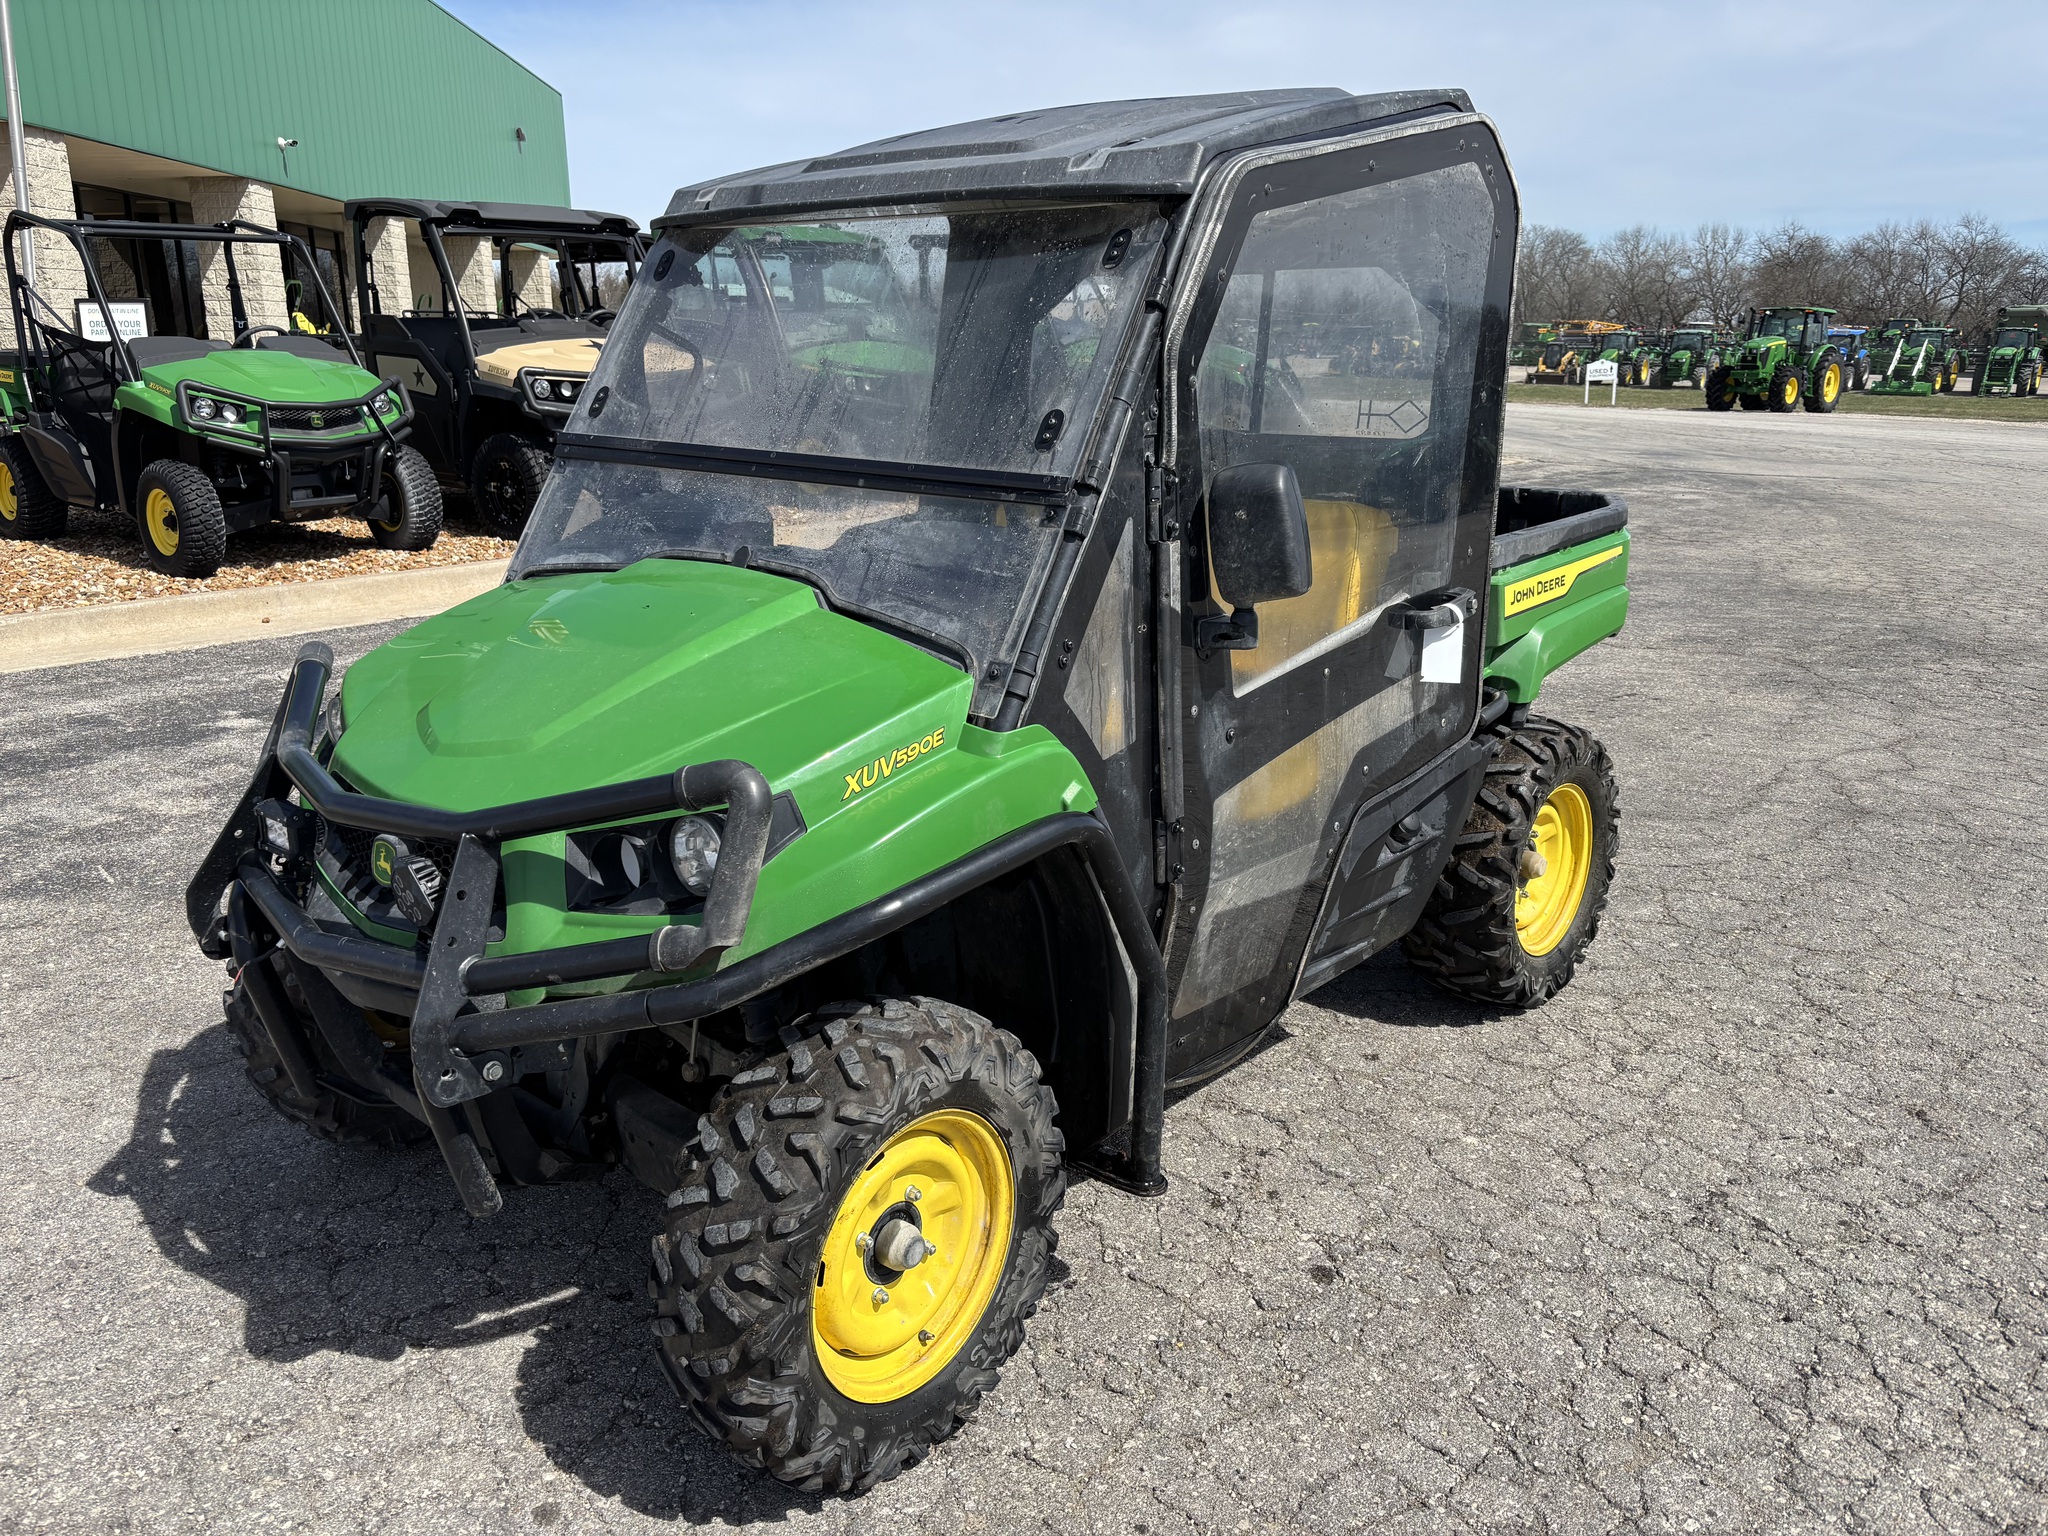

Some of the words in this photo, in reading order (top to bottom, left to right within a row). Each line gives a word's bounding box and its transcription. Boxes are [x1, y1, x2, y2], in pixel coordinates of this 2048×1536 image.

[118, 320, 141, 328] YOUR
[1510, 586, 1535, 606] JOHN
[1537, 574, 1566, 596] DEERE
[840, 726, 945, 802] XUV590E
